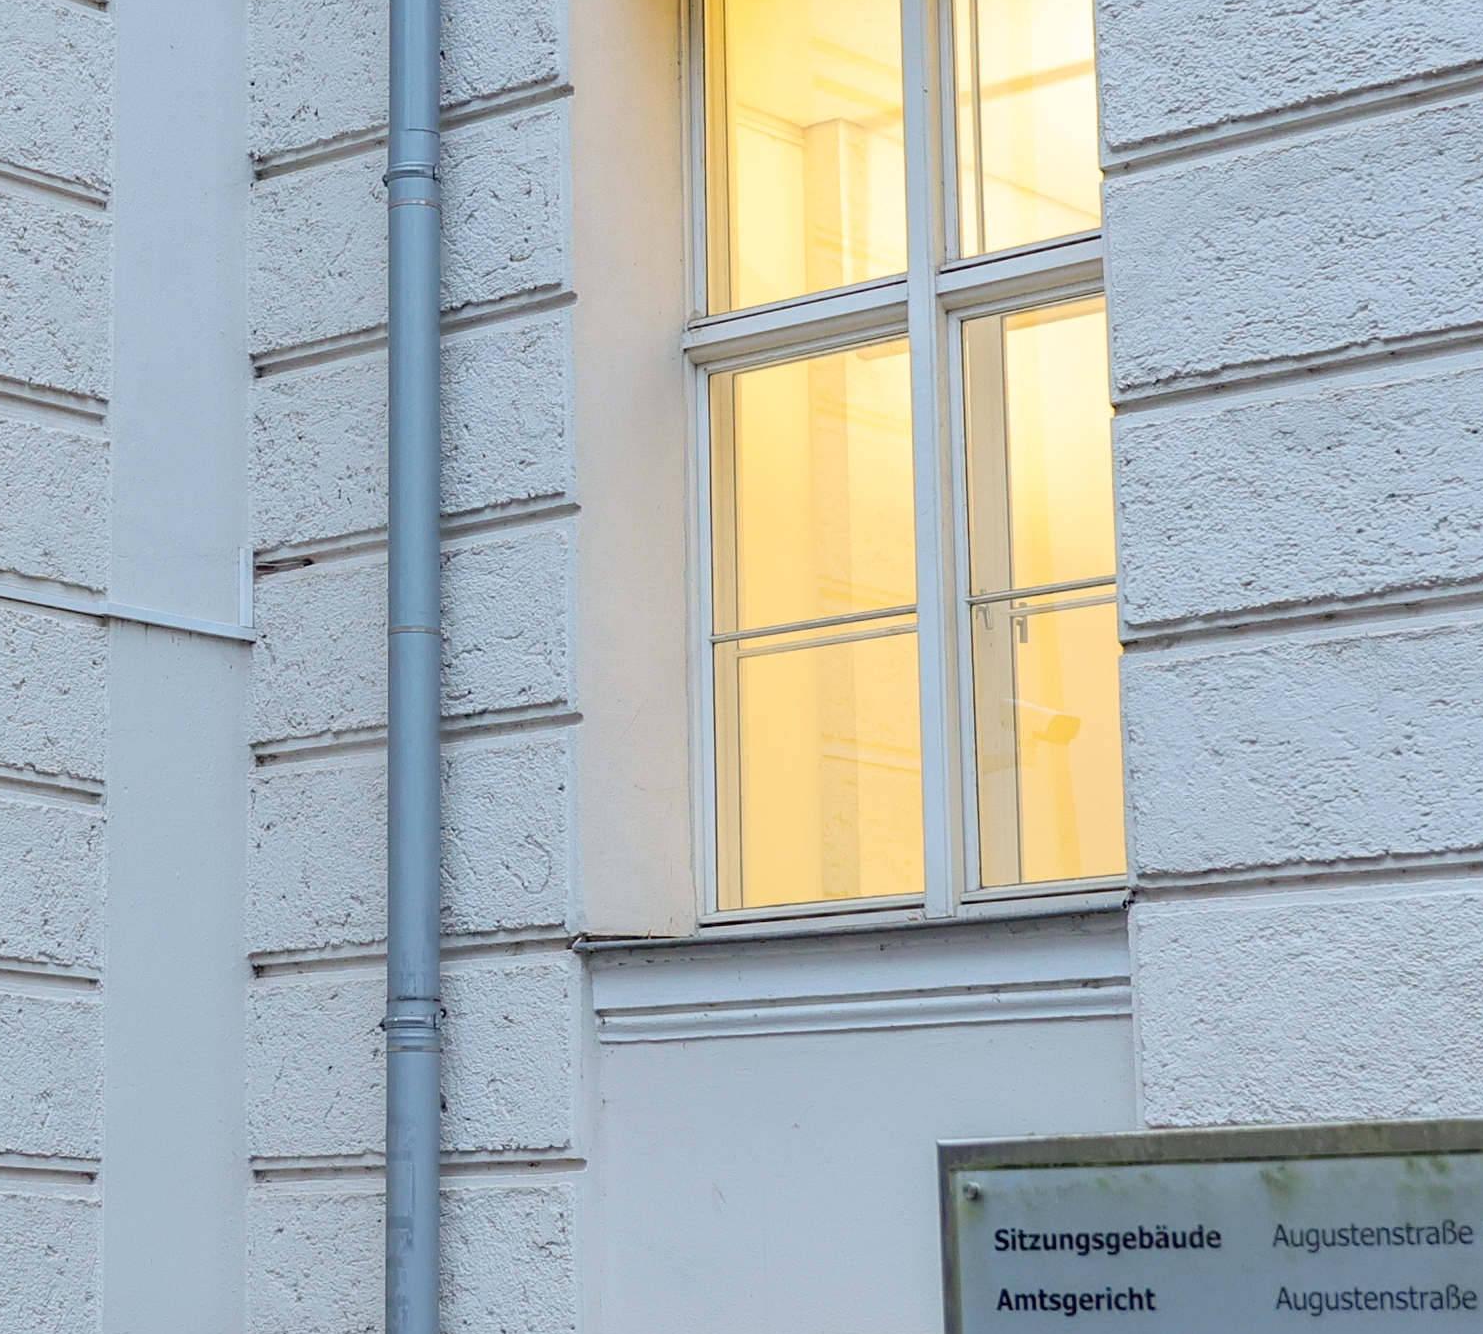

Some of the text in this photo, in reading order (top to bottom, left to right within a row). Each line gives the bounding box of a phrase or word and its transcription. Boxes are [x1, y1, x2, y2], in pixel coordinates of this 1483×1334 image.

[994, 1224, 1222, 1256] Sitzungsgebäude
[1272, 1219, 1474, 1253] Augustenstraße
[997, 1286, 1157, 1317] Amtsgericht
[1275, 1284, 1478, 1317] Augustenstraße
